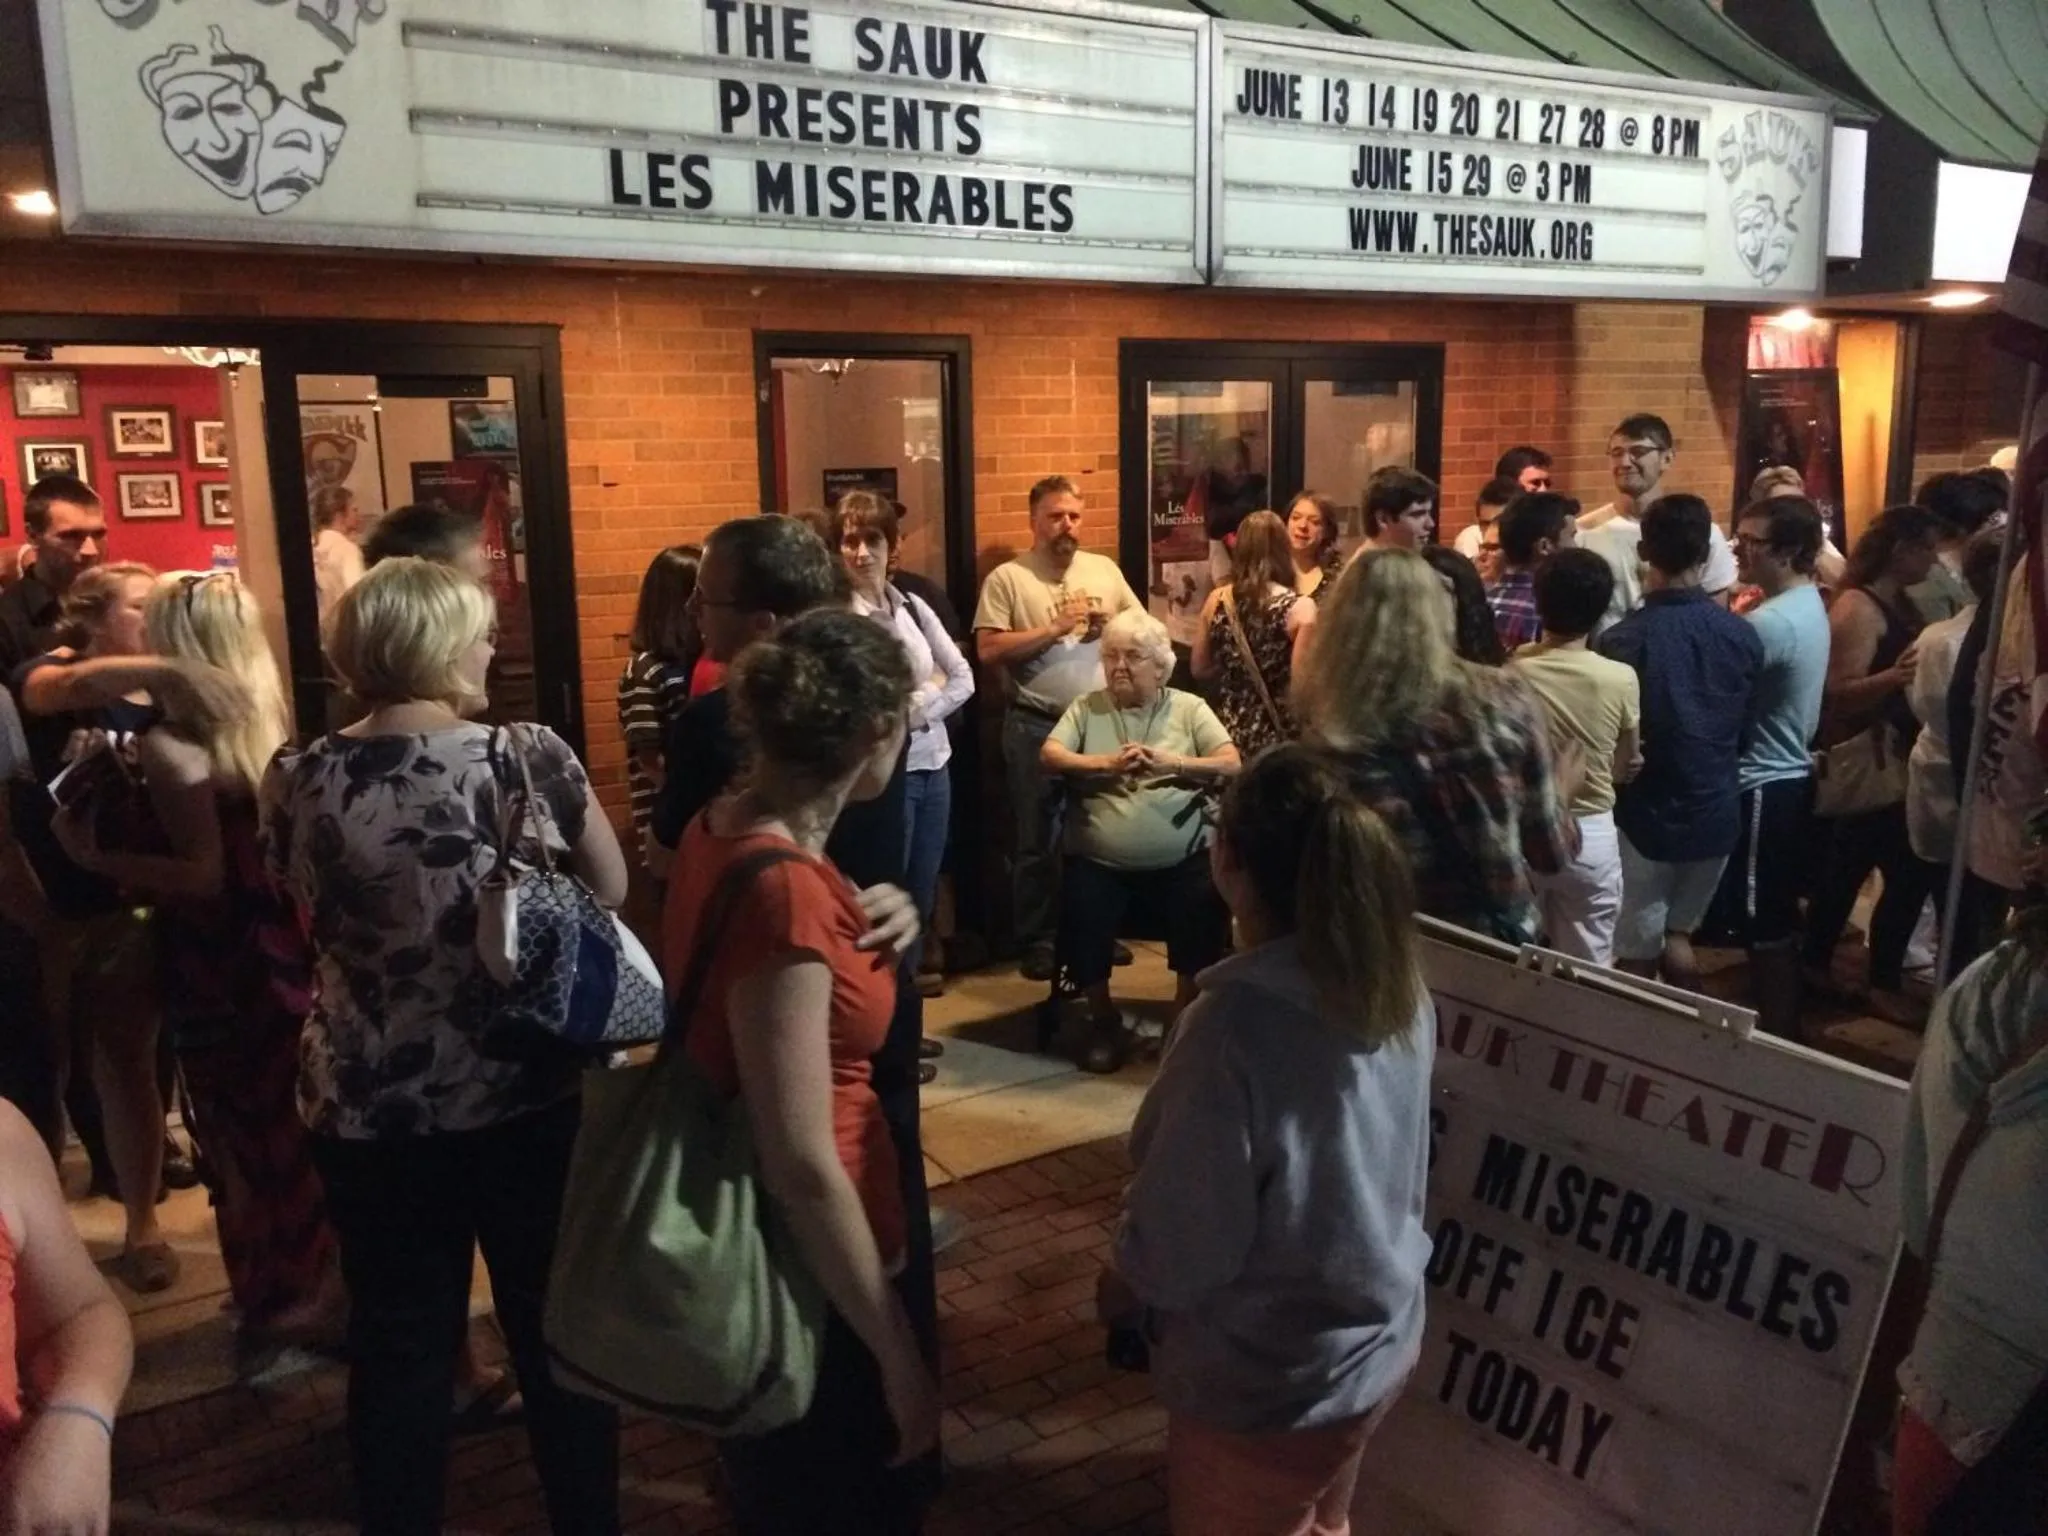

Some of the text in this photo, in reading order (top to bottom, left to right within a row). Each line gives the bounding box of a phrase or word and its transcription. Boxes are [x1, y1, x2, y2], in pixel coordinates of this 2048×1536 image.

[706, 2, 990, 84] THE SAUK
[718, 79, 983, 156] PRESENTS
[1237, 68, 1301, 120] JUNE
[1322, 78, 1349, 126] 13
[1368, 82, 1395, 128] 14
[1413, 87, 1437, 132] 19
[1450, 93, 1480, 136] 20
[1496, 98, 1520, 141] 21
[1539, 102, 1566, 145] 27
[1579, 107, 1605, 149] 28
[1619, 117, 1639, 146] @
[609, 148, 1074, 233] LES MISERABLES
[1352, 144, 1412, 191] JUNE
[1428, 150, 1451, 193] 15
[1463, 154, 1491, 196] 29
[1506, 163, 1527, 193] @
[1350, 207, 1593, 261] WWW.THESAUK.ORG
[1549, 1044, 1887, 1207] THEATER
[1472, 1133, 1851, 1354] MISERABLES
[1438, 1331, 1614, 1480] TODAY
